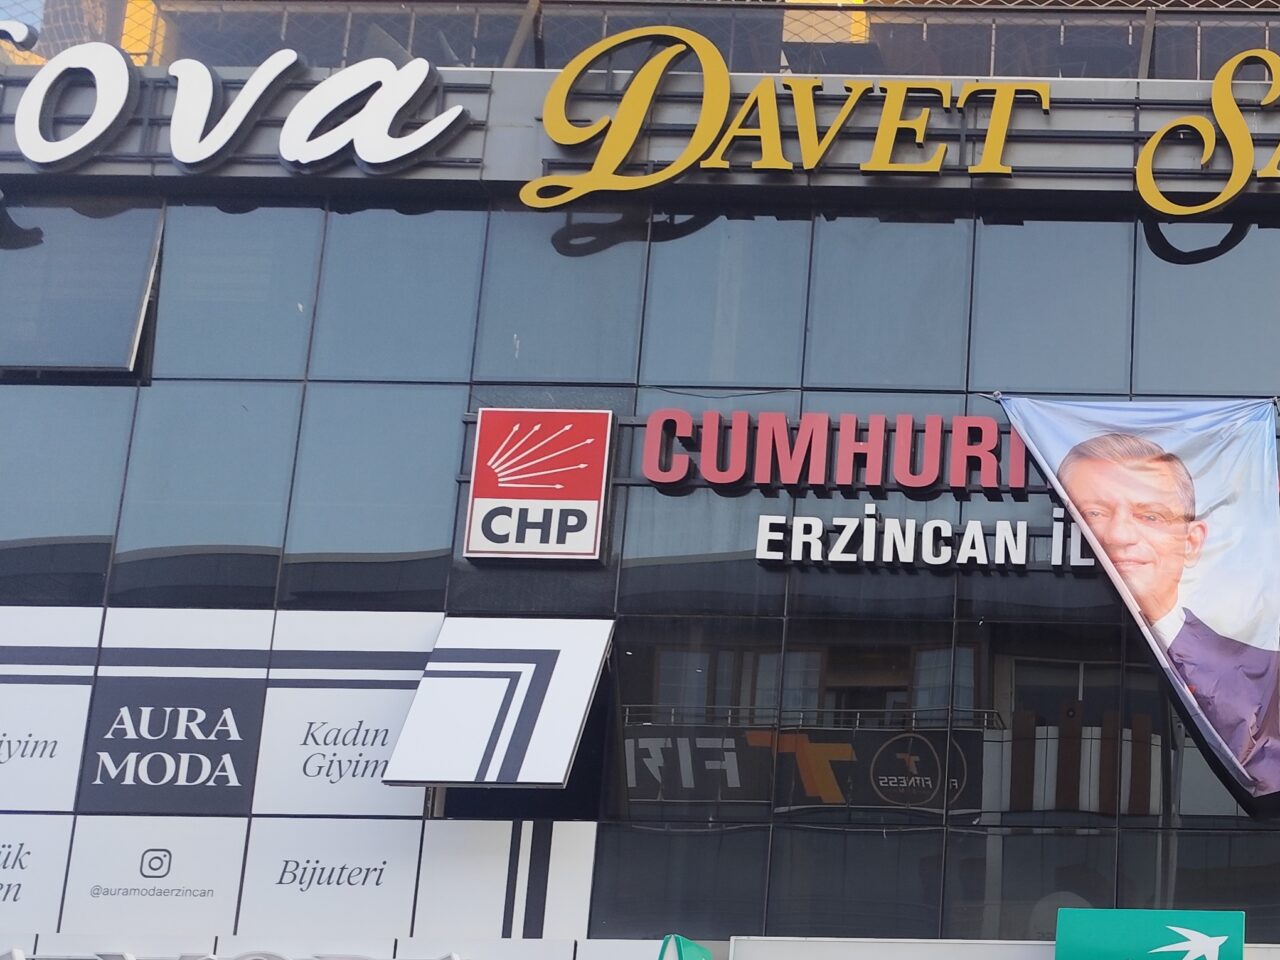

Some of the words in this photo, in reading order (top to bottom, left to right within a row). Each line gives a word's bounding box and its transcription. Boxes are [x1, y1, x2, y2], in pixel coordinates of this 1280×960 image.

[480, 506, 588, 546] CHP
[755, 503, 1028, 566] ERZİNCAN
[103, 705, 244, 741] AURA
[298, 719, 390, 747] Kadın
[91, 751, 243, 787] MODA
[302, 752, 390, 784] Giyim
[89, 884, 215, 899] @auramodaerzincan
[274, 859, 388, 893] Bijuteri
